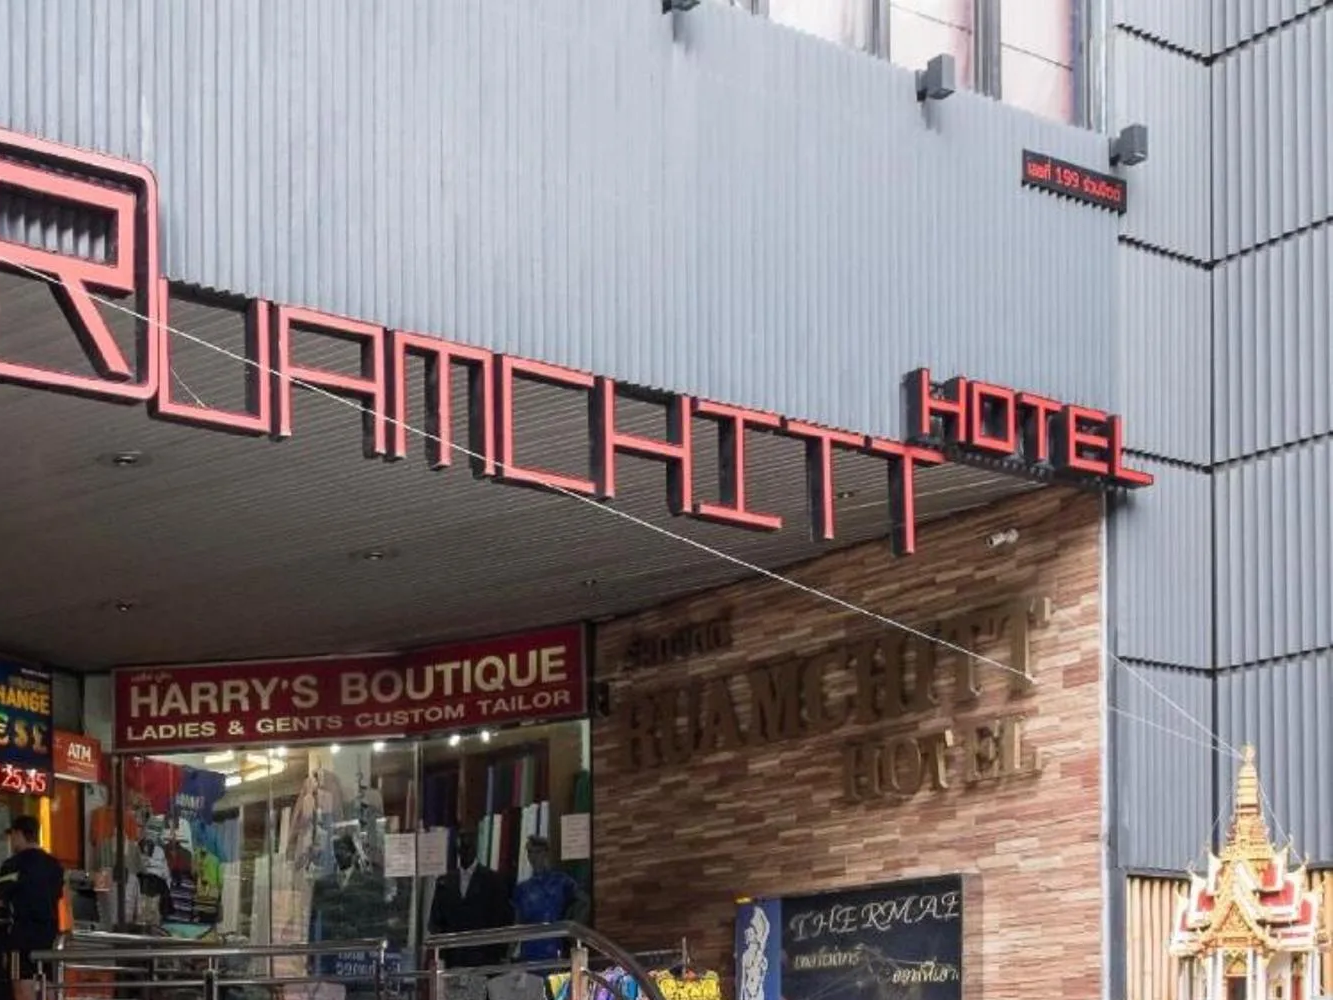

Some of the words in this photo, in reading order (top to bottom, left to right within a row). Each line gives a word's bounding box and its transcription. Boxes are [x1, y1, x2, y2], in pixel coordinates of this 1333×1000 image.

[1055, 165, 1080, 188] 199
[914, 367, 1154, 487] HOTEL
[129, 674, 320, 718] HARRY'S
[340, 645, 567, 706] BOUTIQUE
[127, 721, 217, 741] LADIES
[228, 719, 245, 736] &
[256, 714, 343, 734] GENTS
[354, 703, 465, 728] CUSTOM
[476, 689, 571, 716] TAILOR
[67, 741, 92, 763] ATM
[838, 713, 1043, 805] HOTEL
